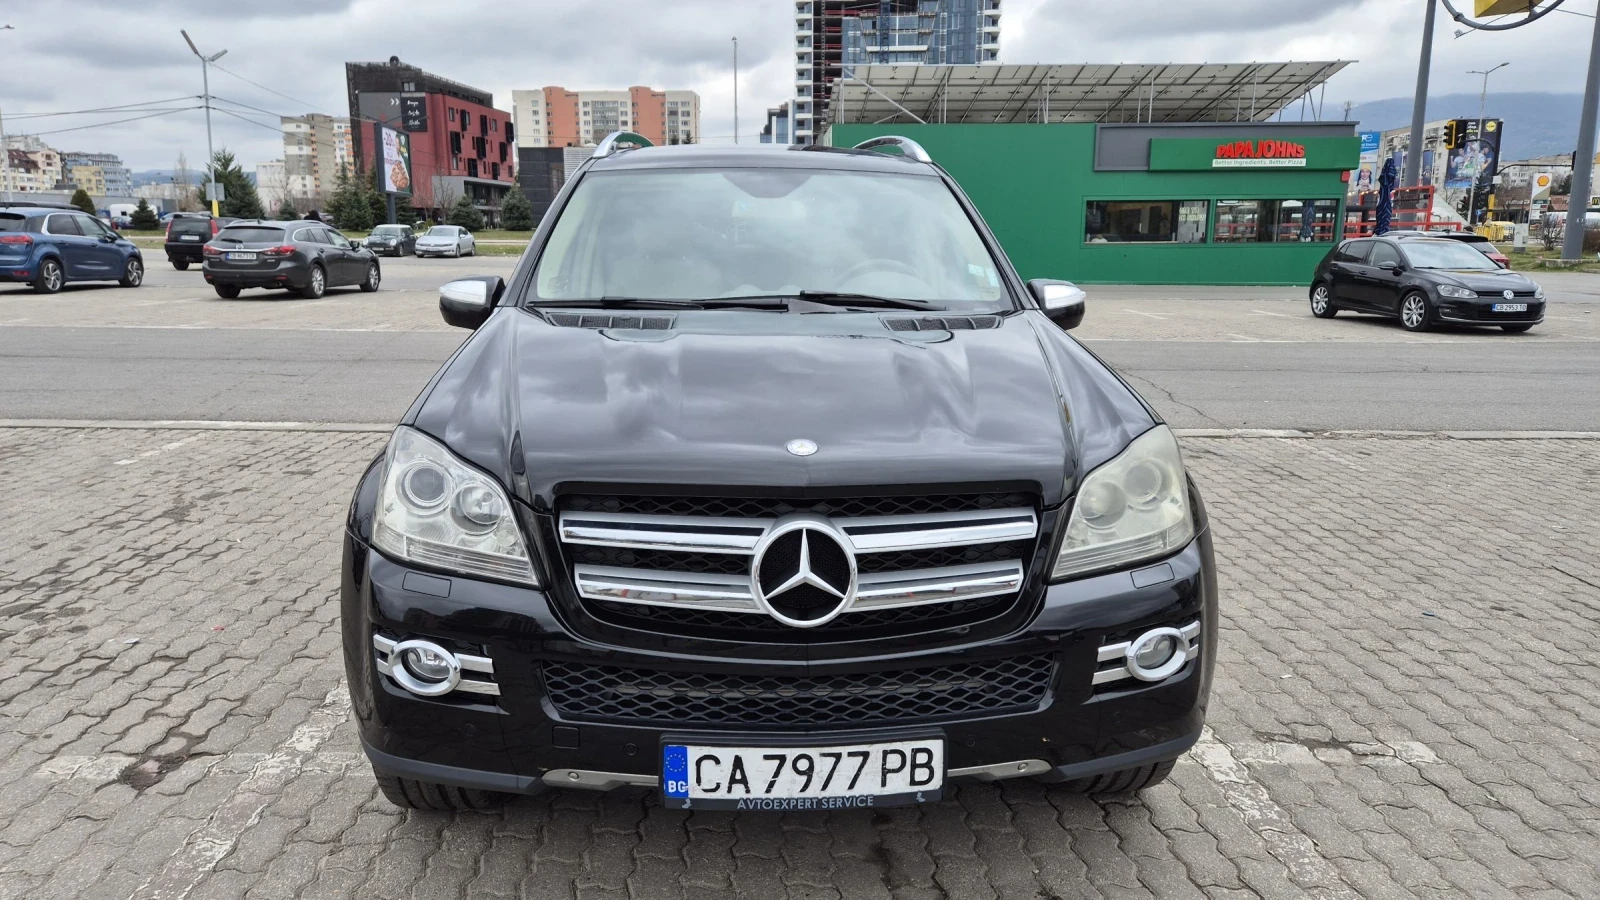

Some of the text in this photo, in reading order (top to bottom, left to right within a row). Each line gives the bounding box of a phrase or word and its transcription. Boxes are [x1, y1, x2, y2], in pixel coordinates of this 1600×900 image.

[1216, 140, 1305, 158] PAPA JOHNS
[695, 747, 935, 794] CA 7977 PB
[668, 780, 688, 793] BG
[737, 796, 874, 810] AVTOEXPERT SERVICE
